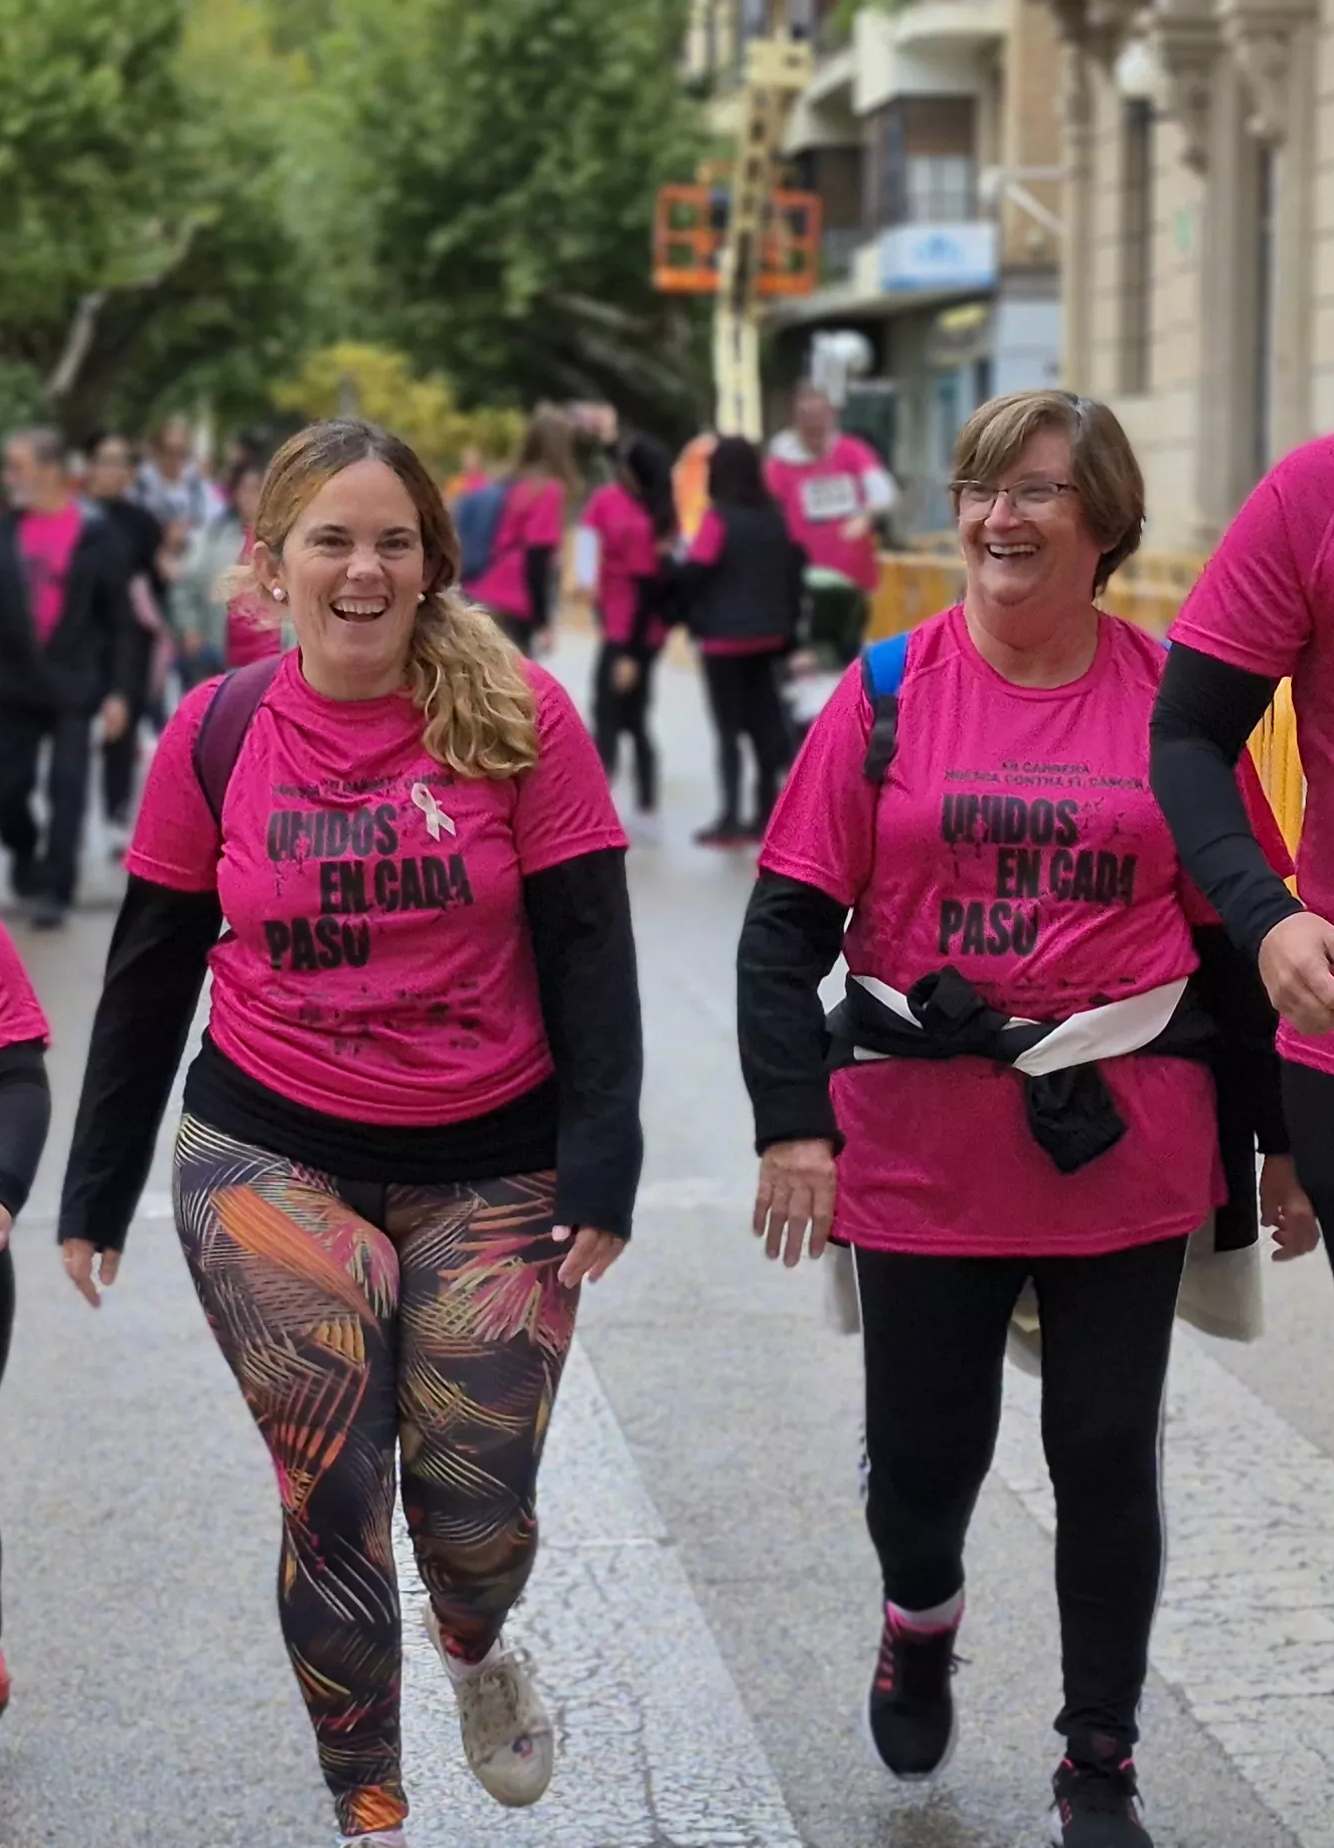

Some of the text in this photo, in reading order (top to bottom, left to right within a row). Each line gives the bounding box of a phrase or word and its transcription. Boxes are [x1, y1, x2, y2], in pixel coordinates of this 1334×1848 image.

[1004, 774, 1065, 787] CONTRA
[1068, 777, 1085, 787] EL
[1022, 762, 1090, 774] CARRERA
[267, 803, 399, 862] UNIDOS
[942, 793, 1080, 847] UNIDOS
[320, 853, 474, 915] EN CADA
[996, 846, 1138, 906] EN CADA
[263, 915, 372, 971] PASO
[938, 898, 1040, 957] PASO
